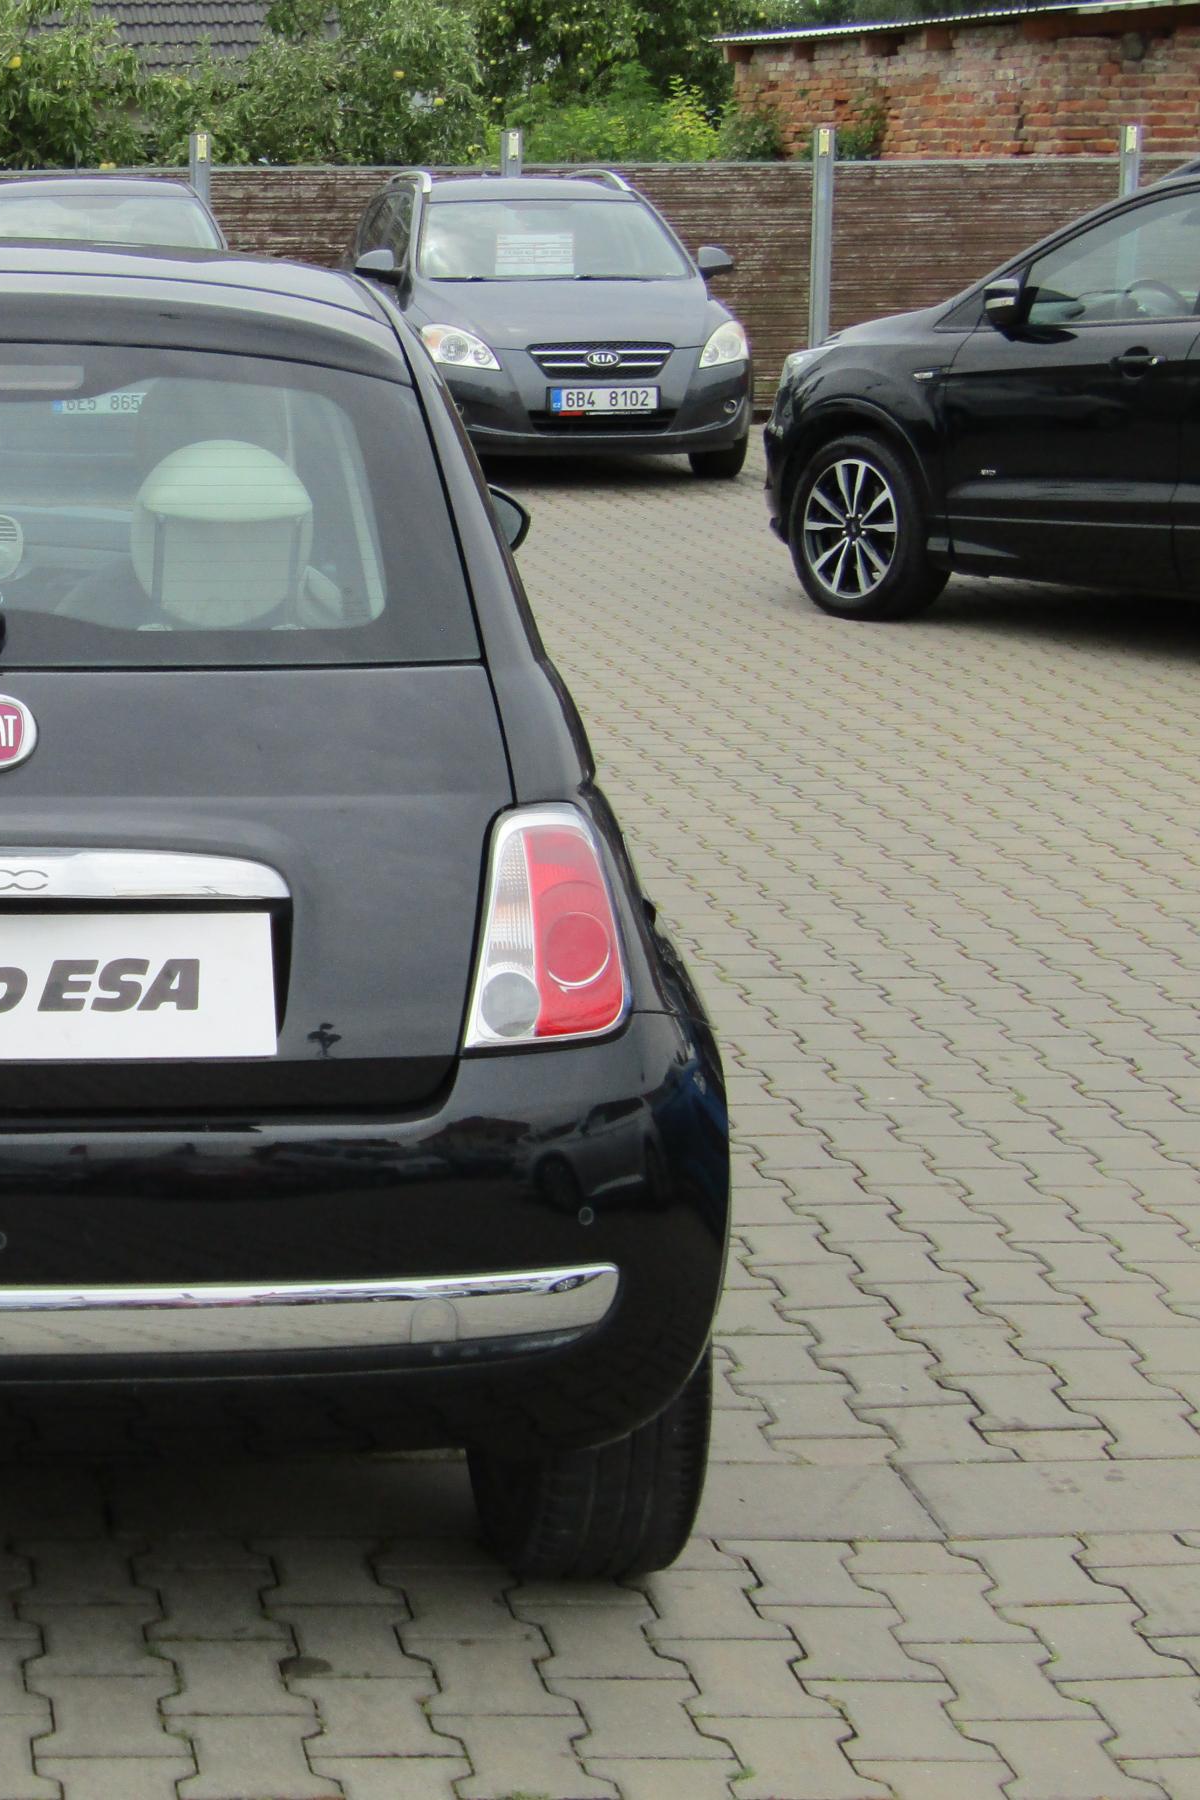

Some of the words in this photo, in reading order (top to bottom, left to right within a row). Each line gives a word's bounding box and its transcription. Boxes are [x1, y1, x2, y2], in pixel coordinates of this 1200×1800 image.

[592, 354, 614, 363] KIA
[110, 395, 141, 410] 865
[566, 391, 596, 408] 6B4
[609, 390, 649, 407] 8102
[37, 958, 201, 1013] ESA
